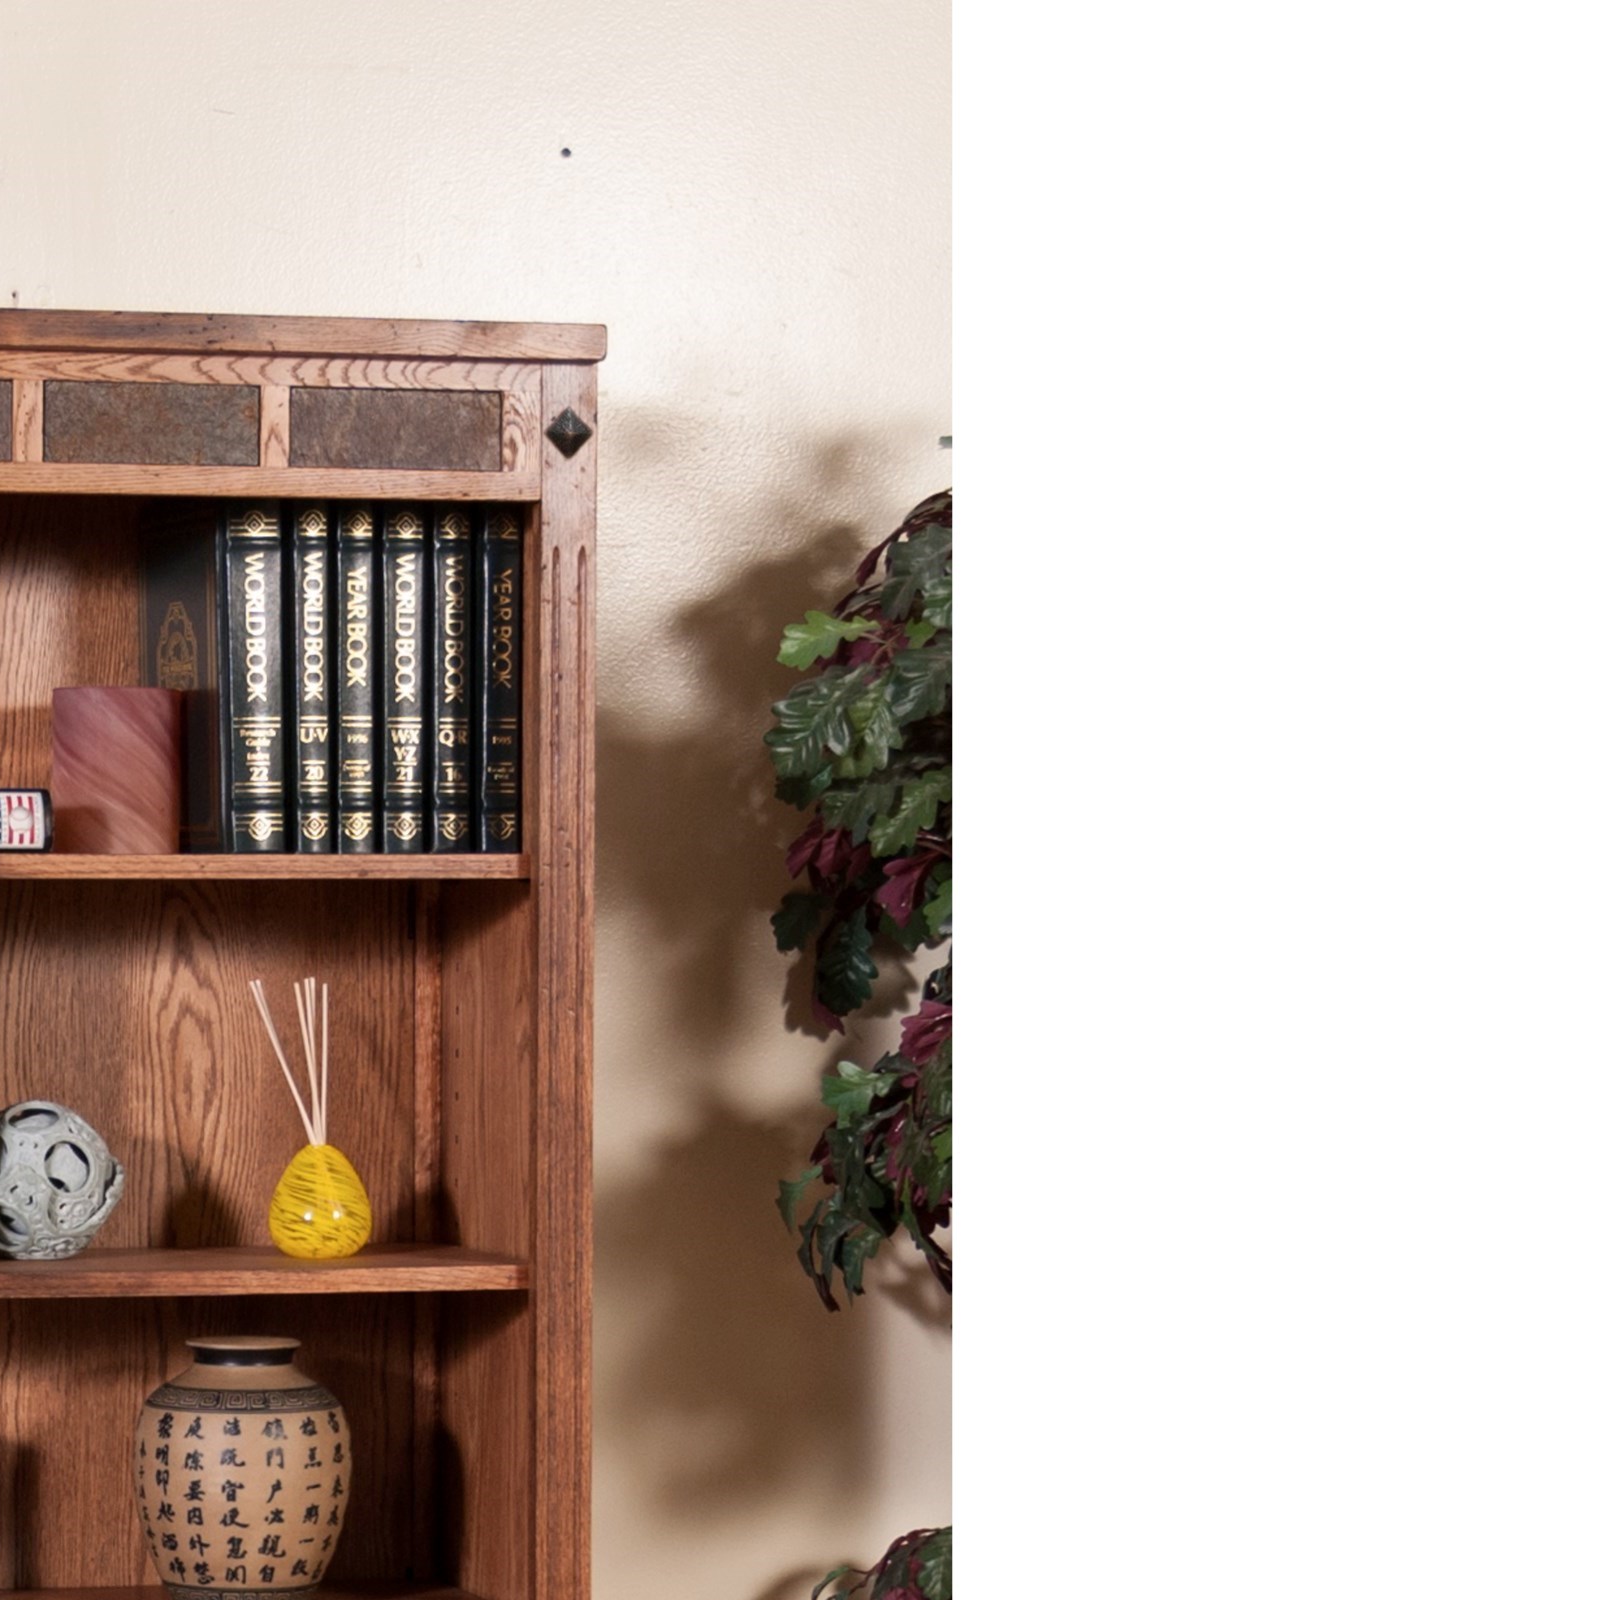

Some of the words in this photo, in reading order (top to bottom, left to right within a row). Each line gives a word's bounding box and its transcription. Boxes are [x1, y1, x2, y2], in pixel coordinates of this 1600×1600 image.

[244, 552, 266, 636] WORLD
[303, 552, 323, 636] WORLD
[347, 566, 367, 620] YEAR
[395, 553, 416, 637] WORLD
[445, 555, 464, 637] WORLD
[493, 568, 512, 620] YEAR
[246, 637, 267, 702] BOOK
[304, 637, 323, 701] BOOK
[347, 624, 367, 687] BOOK
[395, 638, 415, 702] BOOK
[445, 640, 464, 703] BOOK
[493, 625, 512, 689] BOOK
[249, 767, 269, 781] 22
[305, 766, 325, 780] 20
[396, 766, 414, 781] 21
